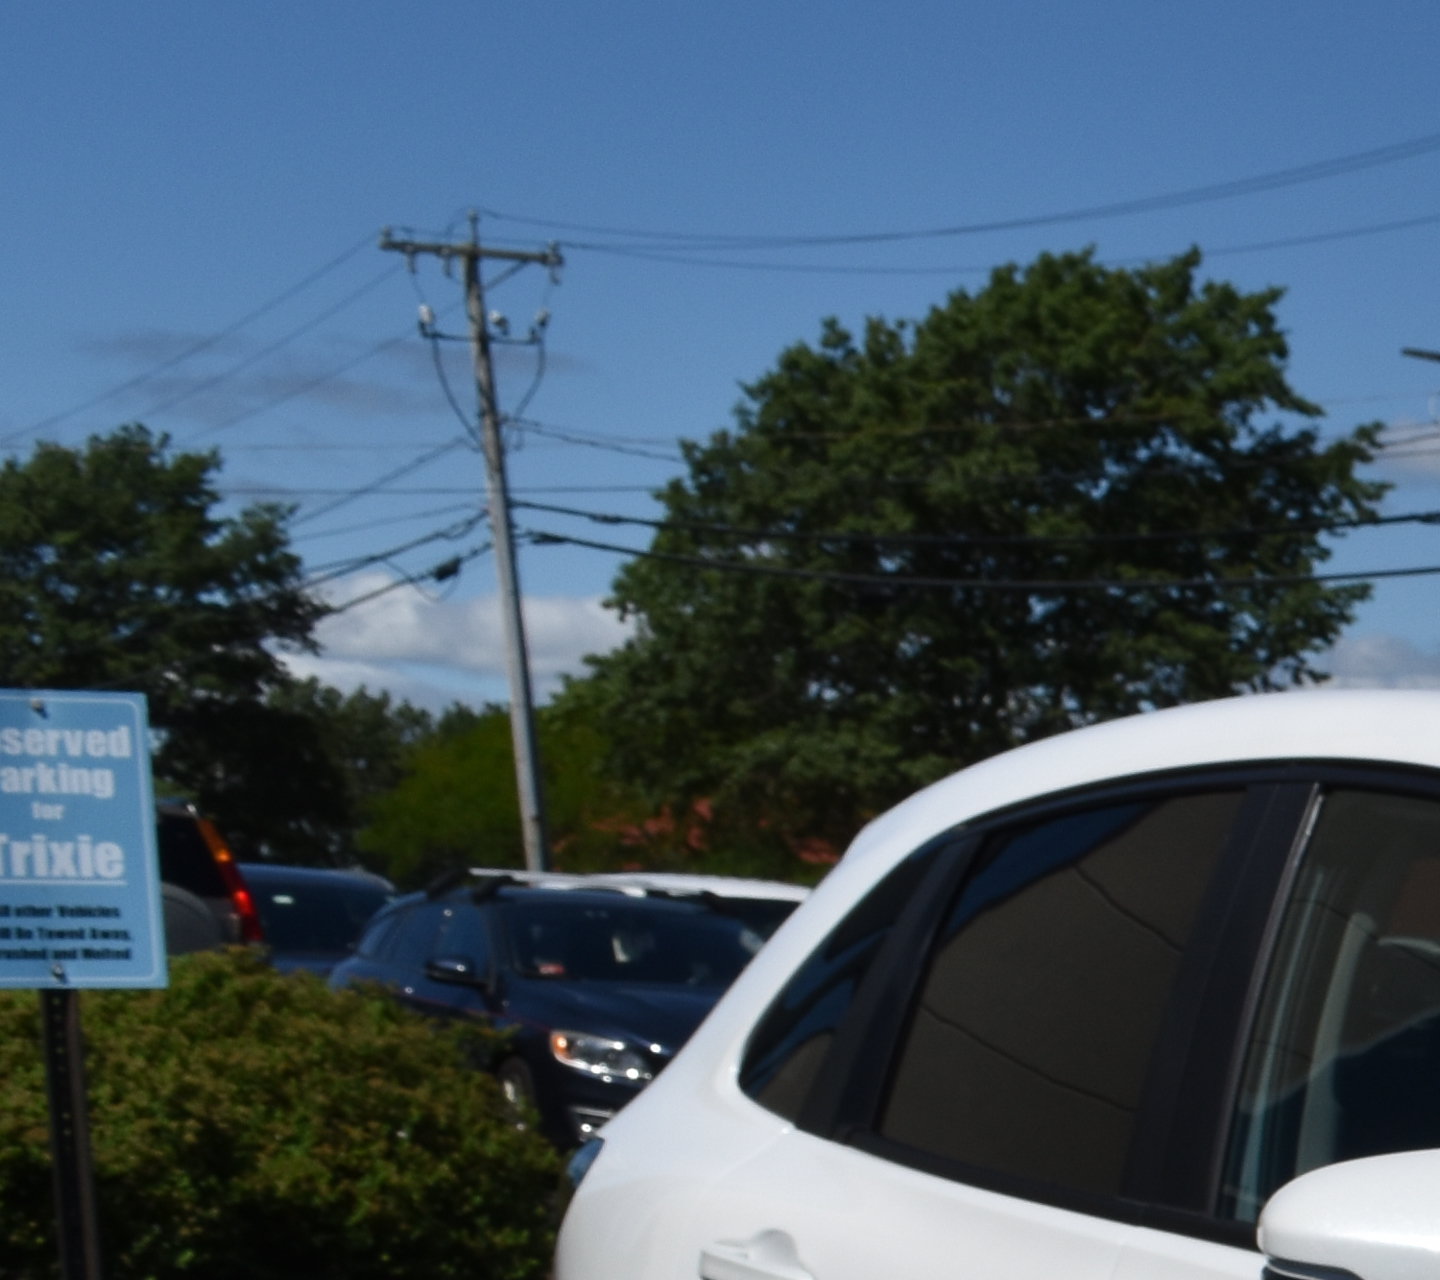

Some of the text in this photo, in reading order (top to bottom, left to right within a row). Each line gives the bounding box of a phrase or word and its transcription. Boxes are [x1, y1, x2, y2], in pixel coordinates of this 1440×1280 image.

[0, 725, 132, 758] served
[0, 762, 115, 799] arking
[31, 801, 65, 821] for
